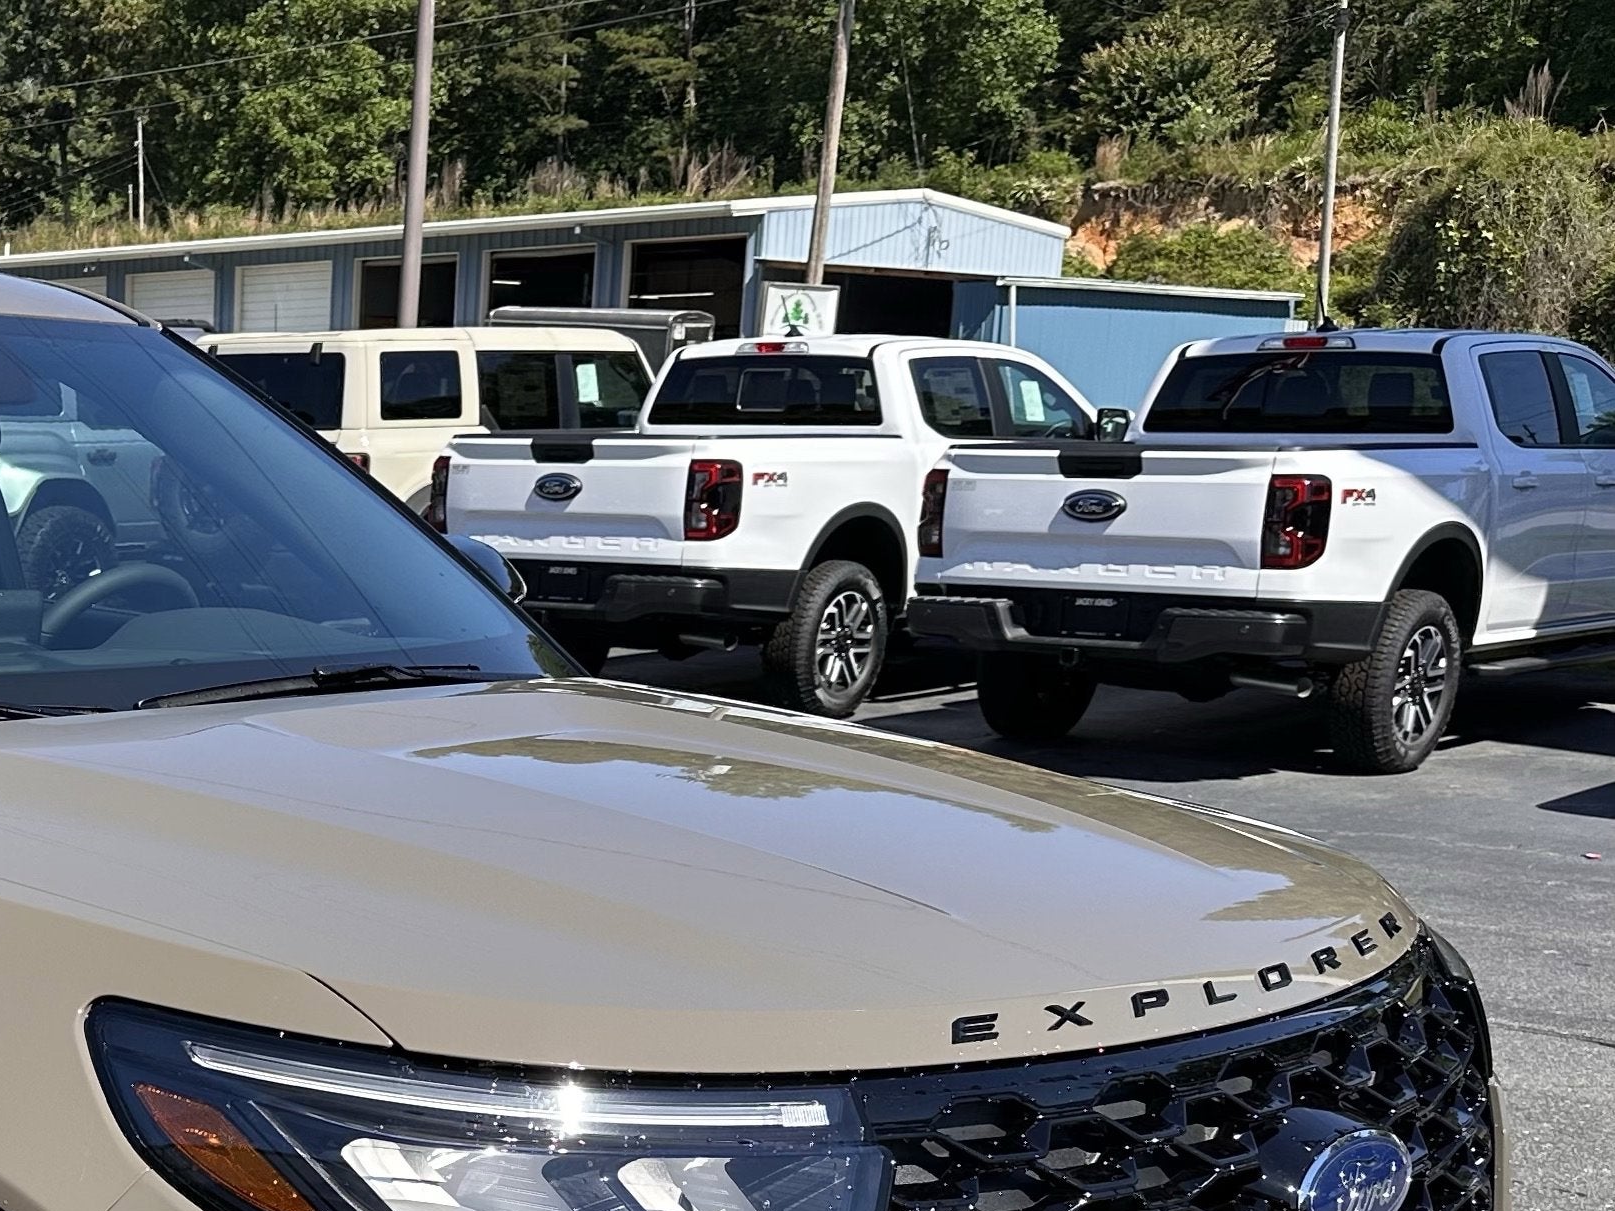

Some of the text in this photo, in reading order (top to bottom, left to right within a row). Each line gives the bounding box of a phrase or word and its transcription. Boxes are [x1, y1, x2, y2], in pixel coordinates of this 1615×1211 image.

[752, 472, 788, 485] FX4
[1341, 488, 1376, 504] FX4
[1074, 498, 1106, 513] Ford
[951, 910, 1403, 1045] EXPLORER
